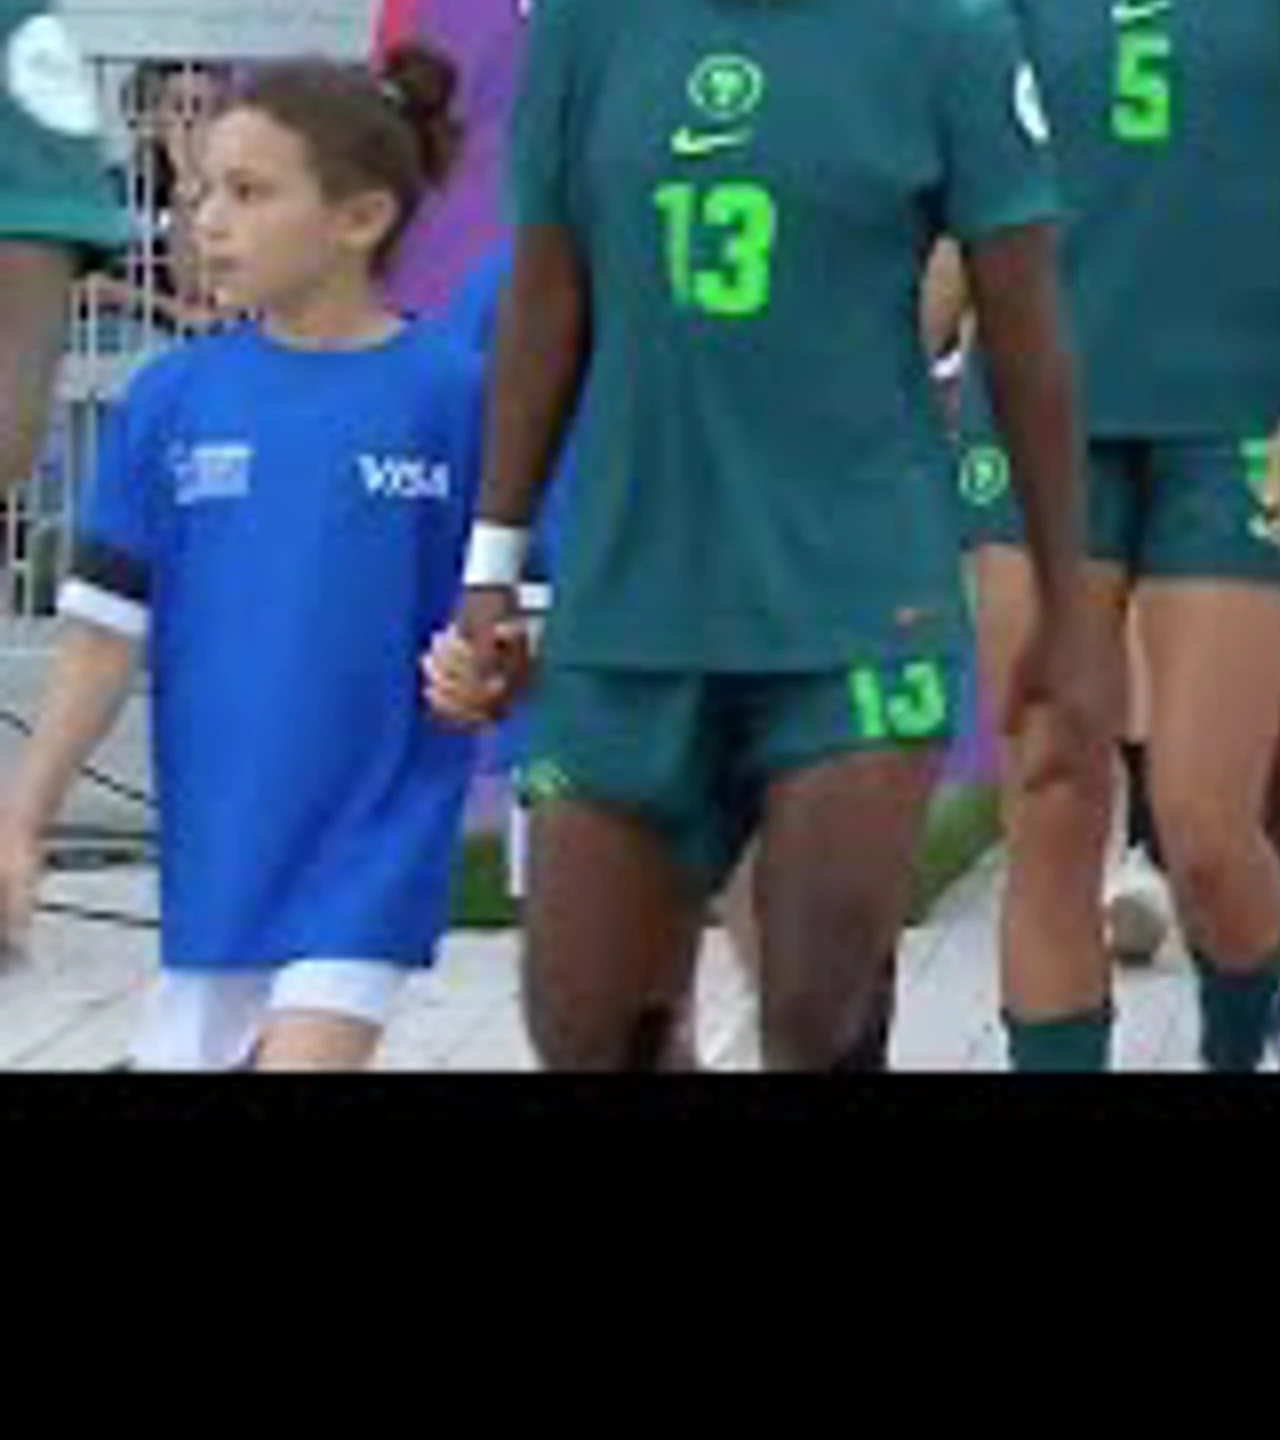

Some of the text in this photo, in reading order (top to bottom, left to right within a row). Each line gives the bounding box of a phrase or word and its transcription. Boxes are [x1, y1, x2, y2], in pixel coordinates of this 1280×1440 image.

[1112, 33, 1171, 138] 5
[654, 184, 777, 314] 13
[357, 454, 450, 499] VISA
[848, 661, 944, 738] 13
